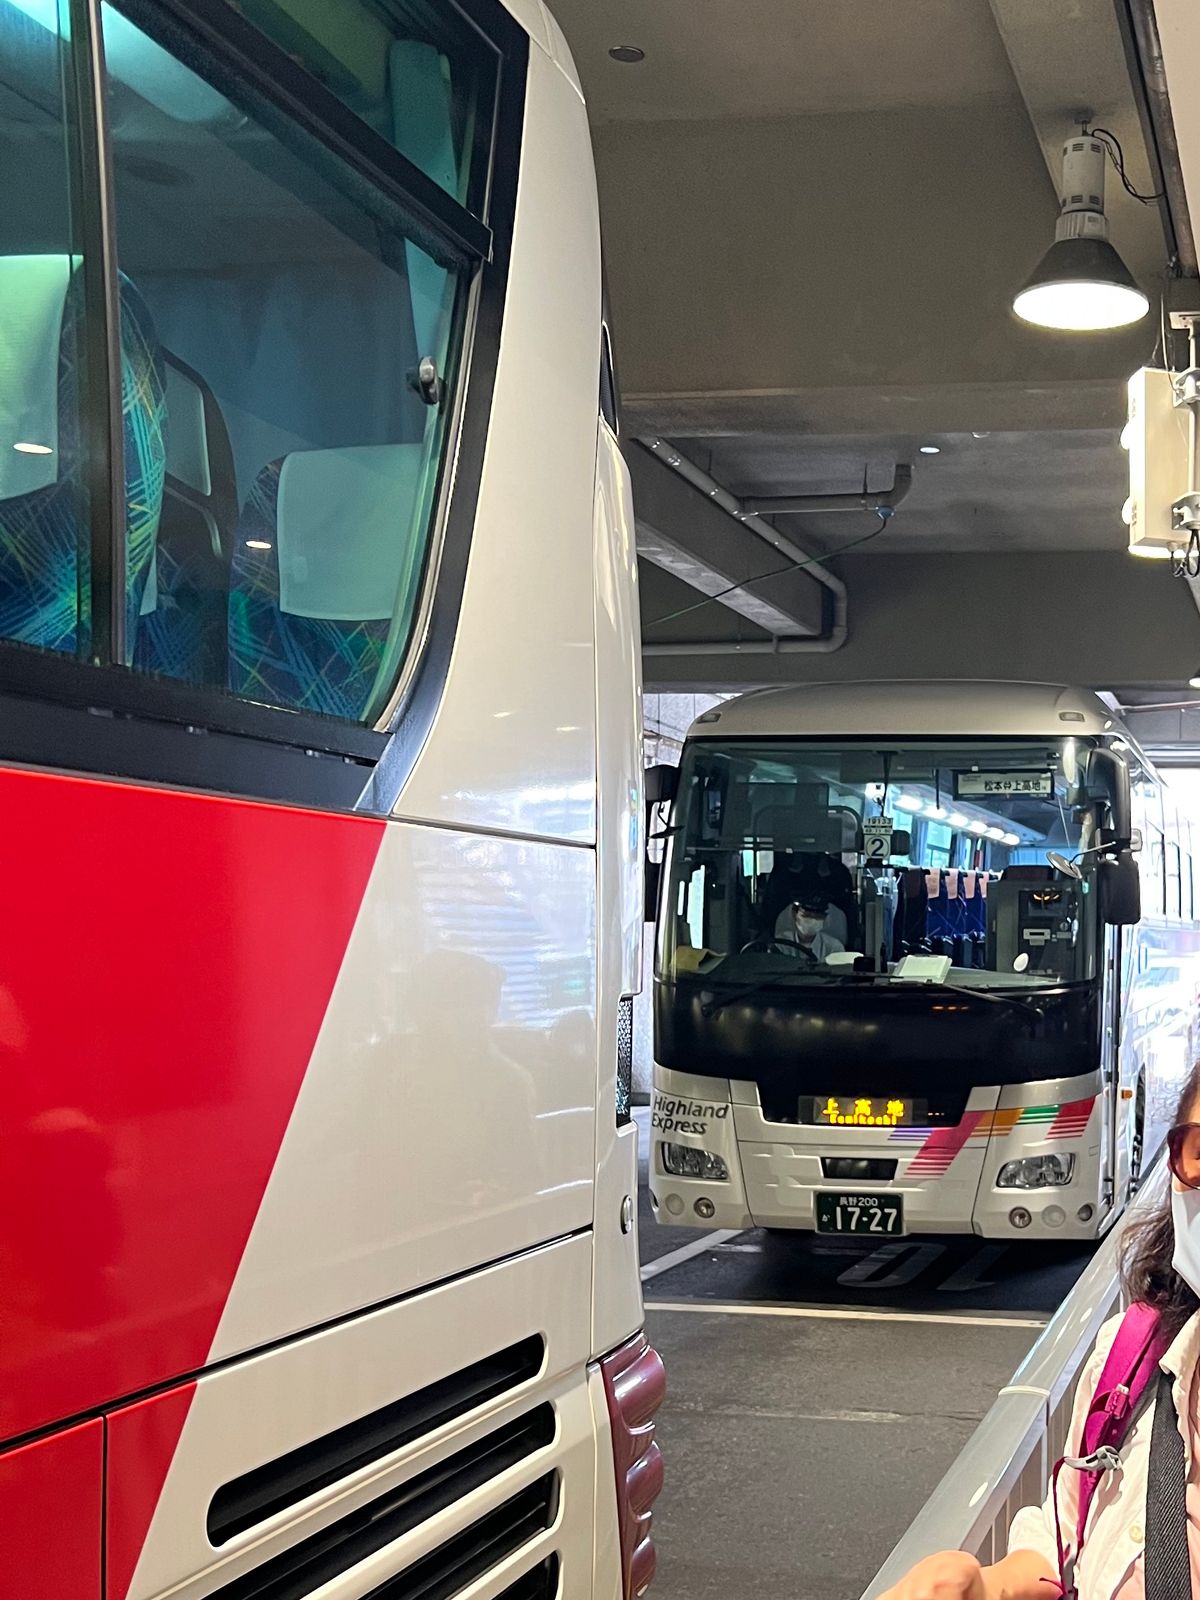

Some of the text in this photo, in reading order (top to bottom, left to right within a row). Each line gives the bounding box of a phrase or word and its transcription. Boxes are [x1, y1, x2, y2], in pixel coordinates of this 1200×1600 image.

[871, 838, 885, 857] 2
[653, 1095, 729, 1119] Highland
[651, 1112, 708, 1134] Express
[835, 1206, 898, 1232] 17-27
